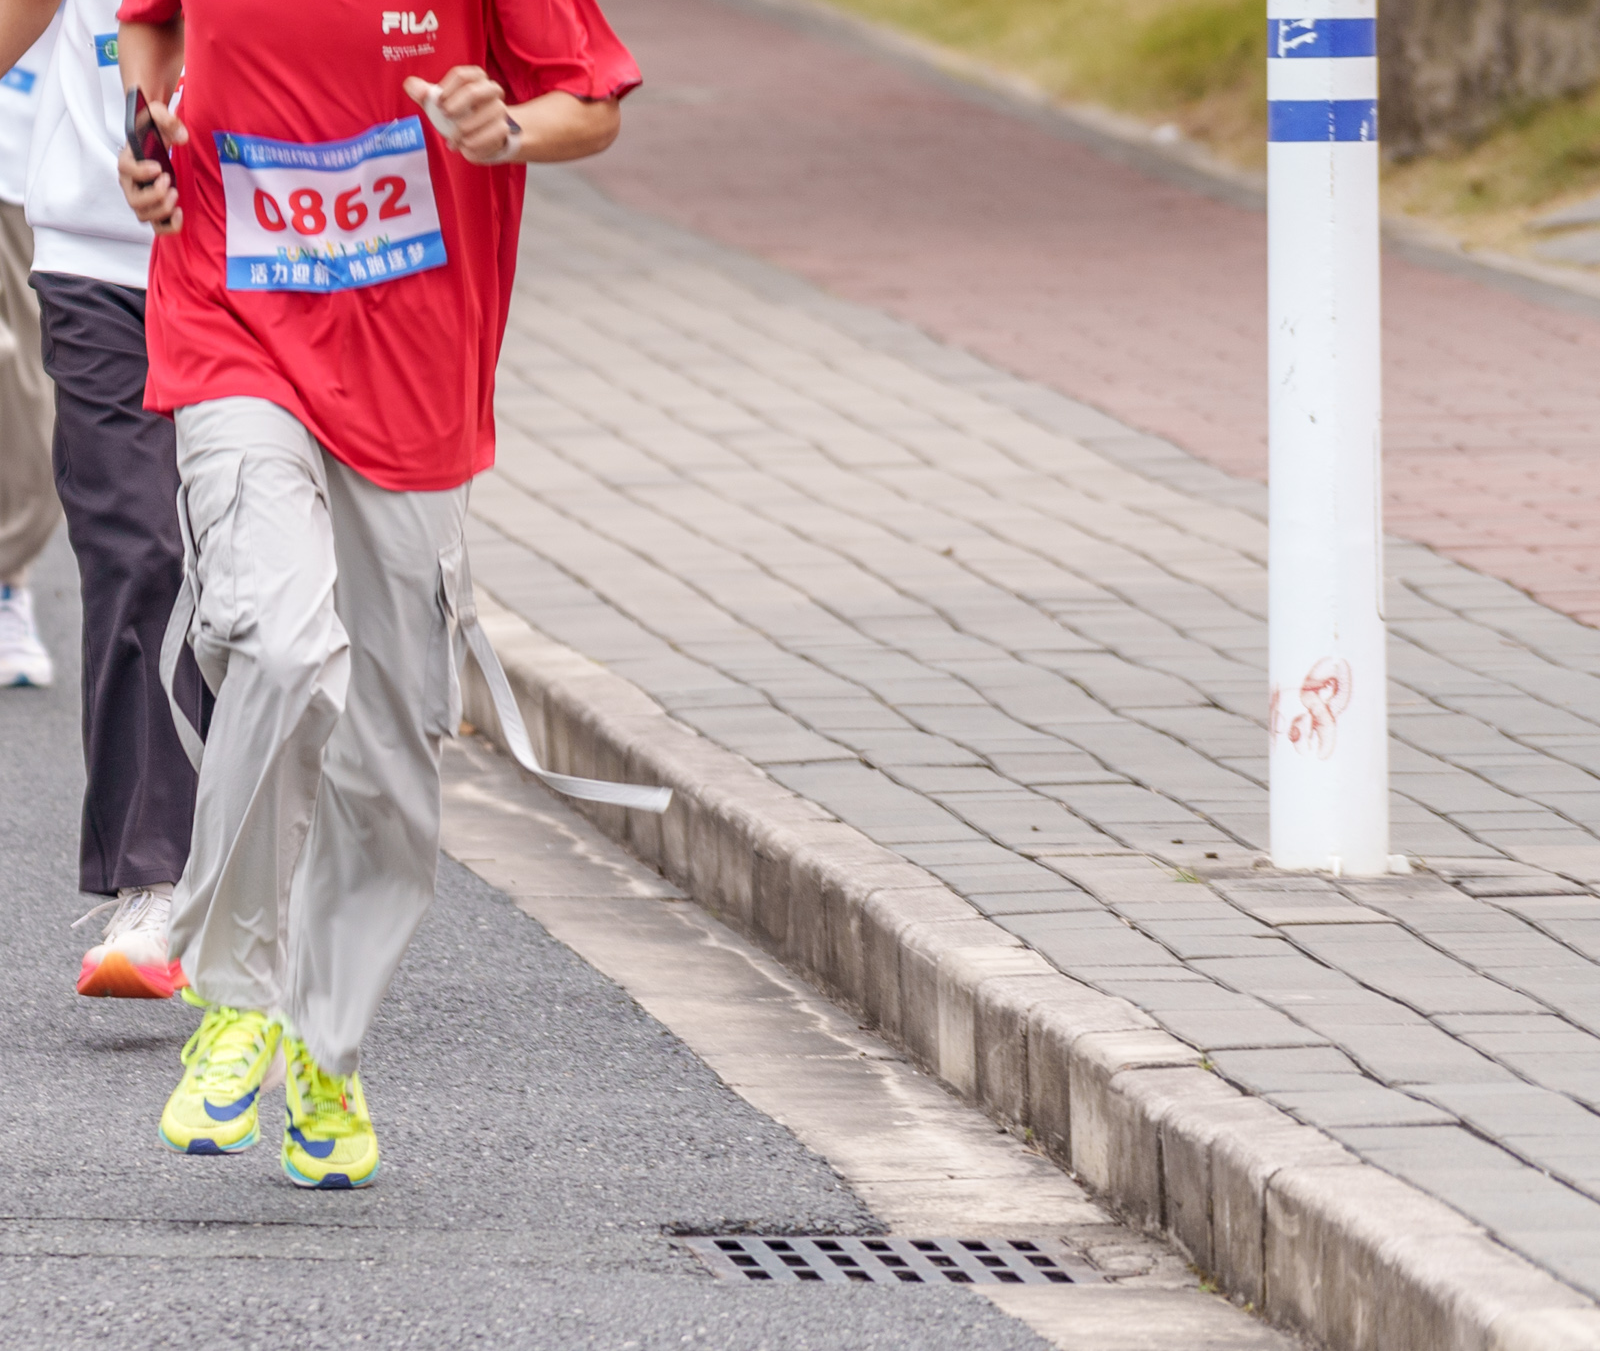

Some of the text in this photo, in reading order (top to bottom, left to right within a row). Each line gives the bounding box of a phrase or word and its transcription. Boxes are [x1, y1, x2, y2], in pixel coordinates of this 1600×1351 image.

[382, 9, 439, 35] FILA
[253, 175, 412, 235] 0862
[250, 261, 330, 286] 活力迎新
[348, 241, 426, 282] 畅跑逐梦
